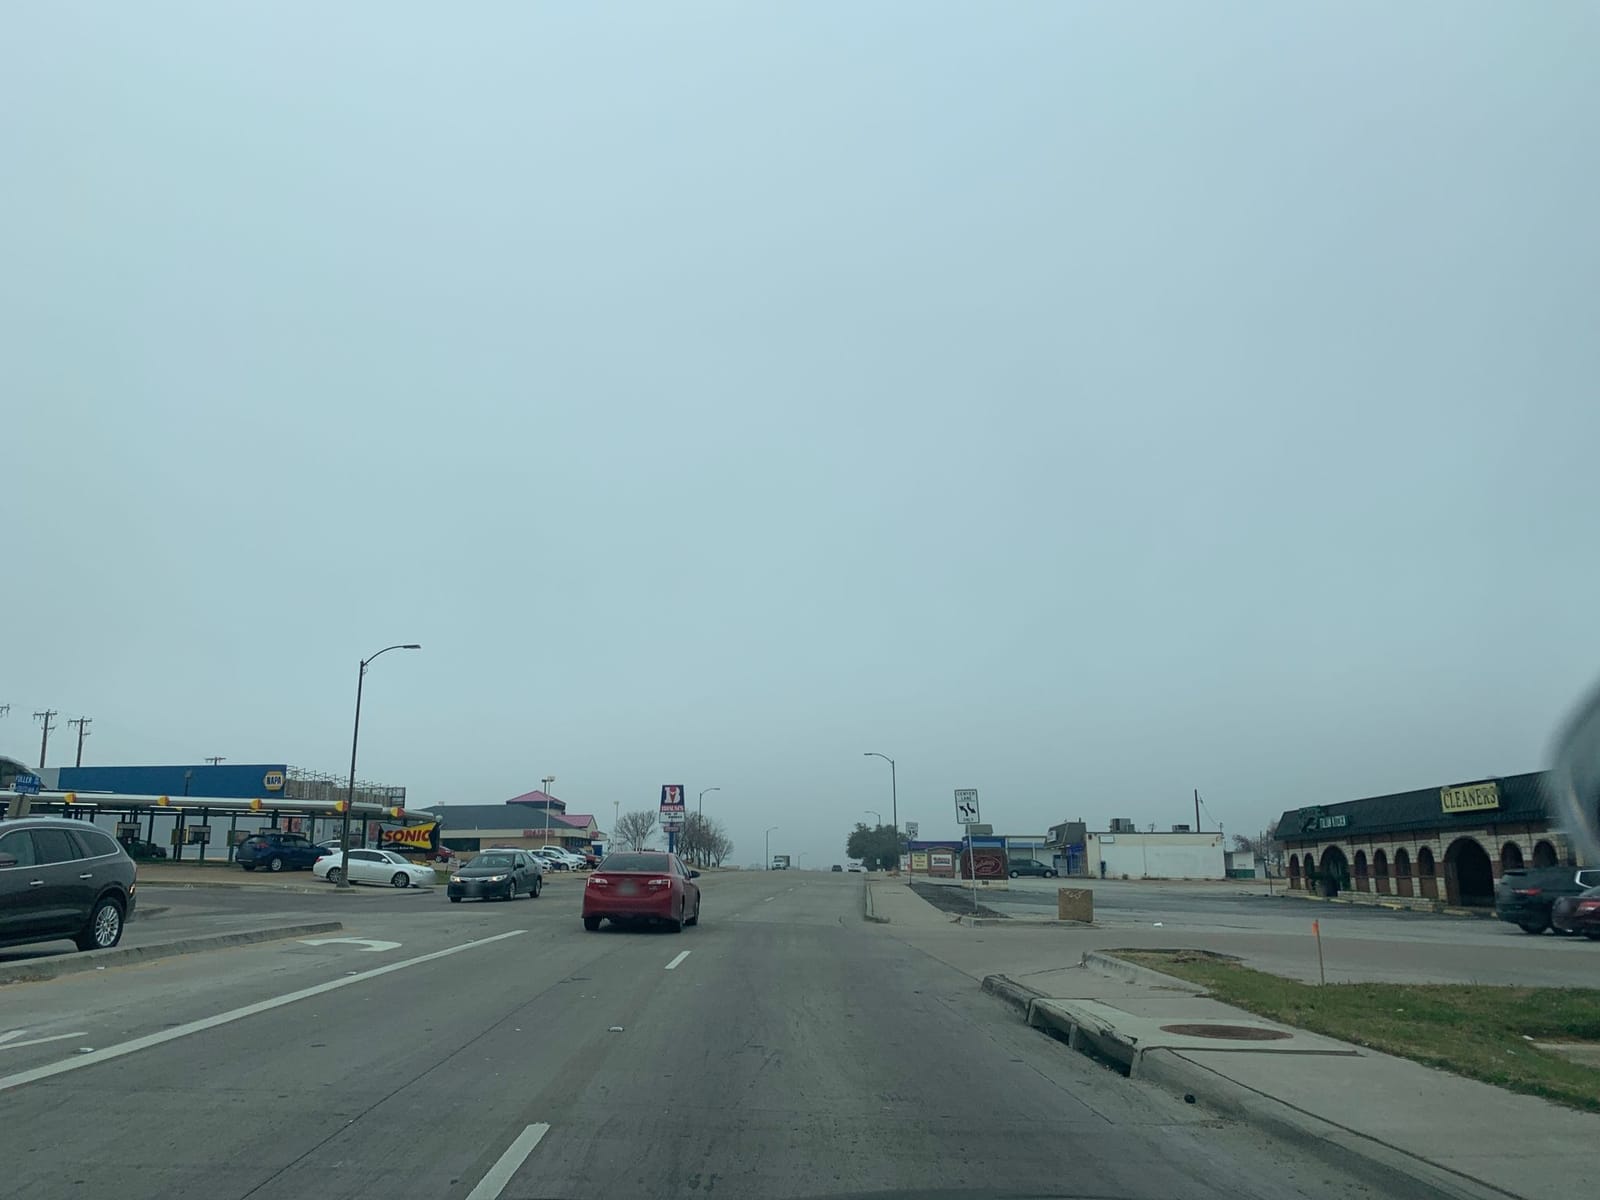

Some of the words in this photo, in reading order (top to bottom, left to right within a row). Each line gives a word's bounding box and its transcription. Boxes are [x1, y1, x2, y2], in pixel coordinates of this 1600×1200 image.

[266, 776, 282, 785] NAPA
[1443, 786, 1497, 809] CLEANERS
[384, 829, 432, 842] SONIC
